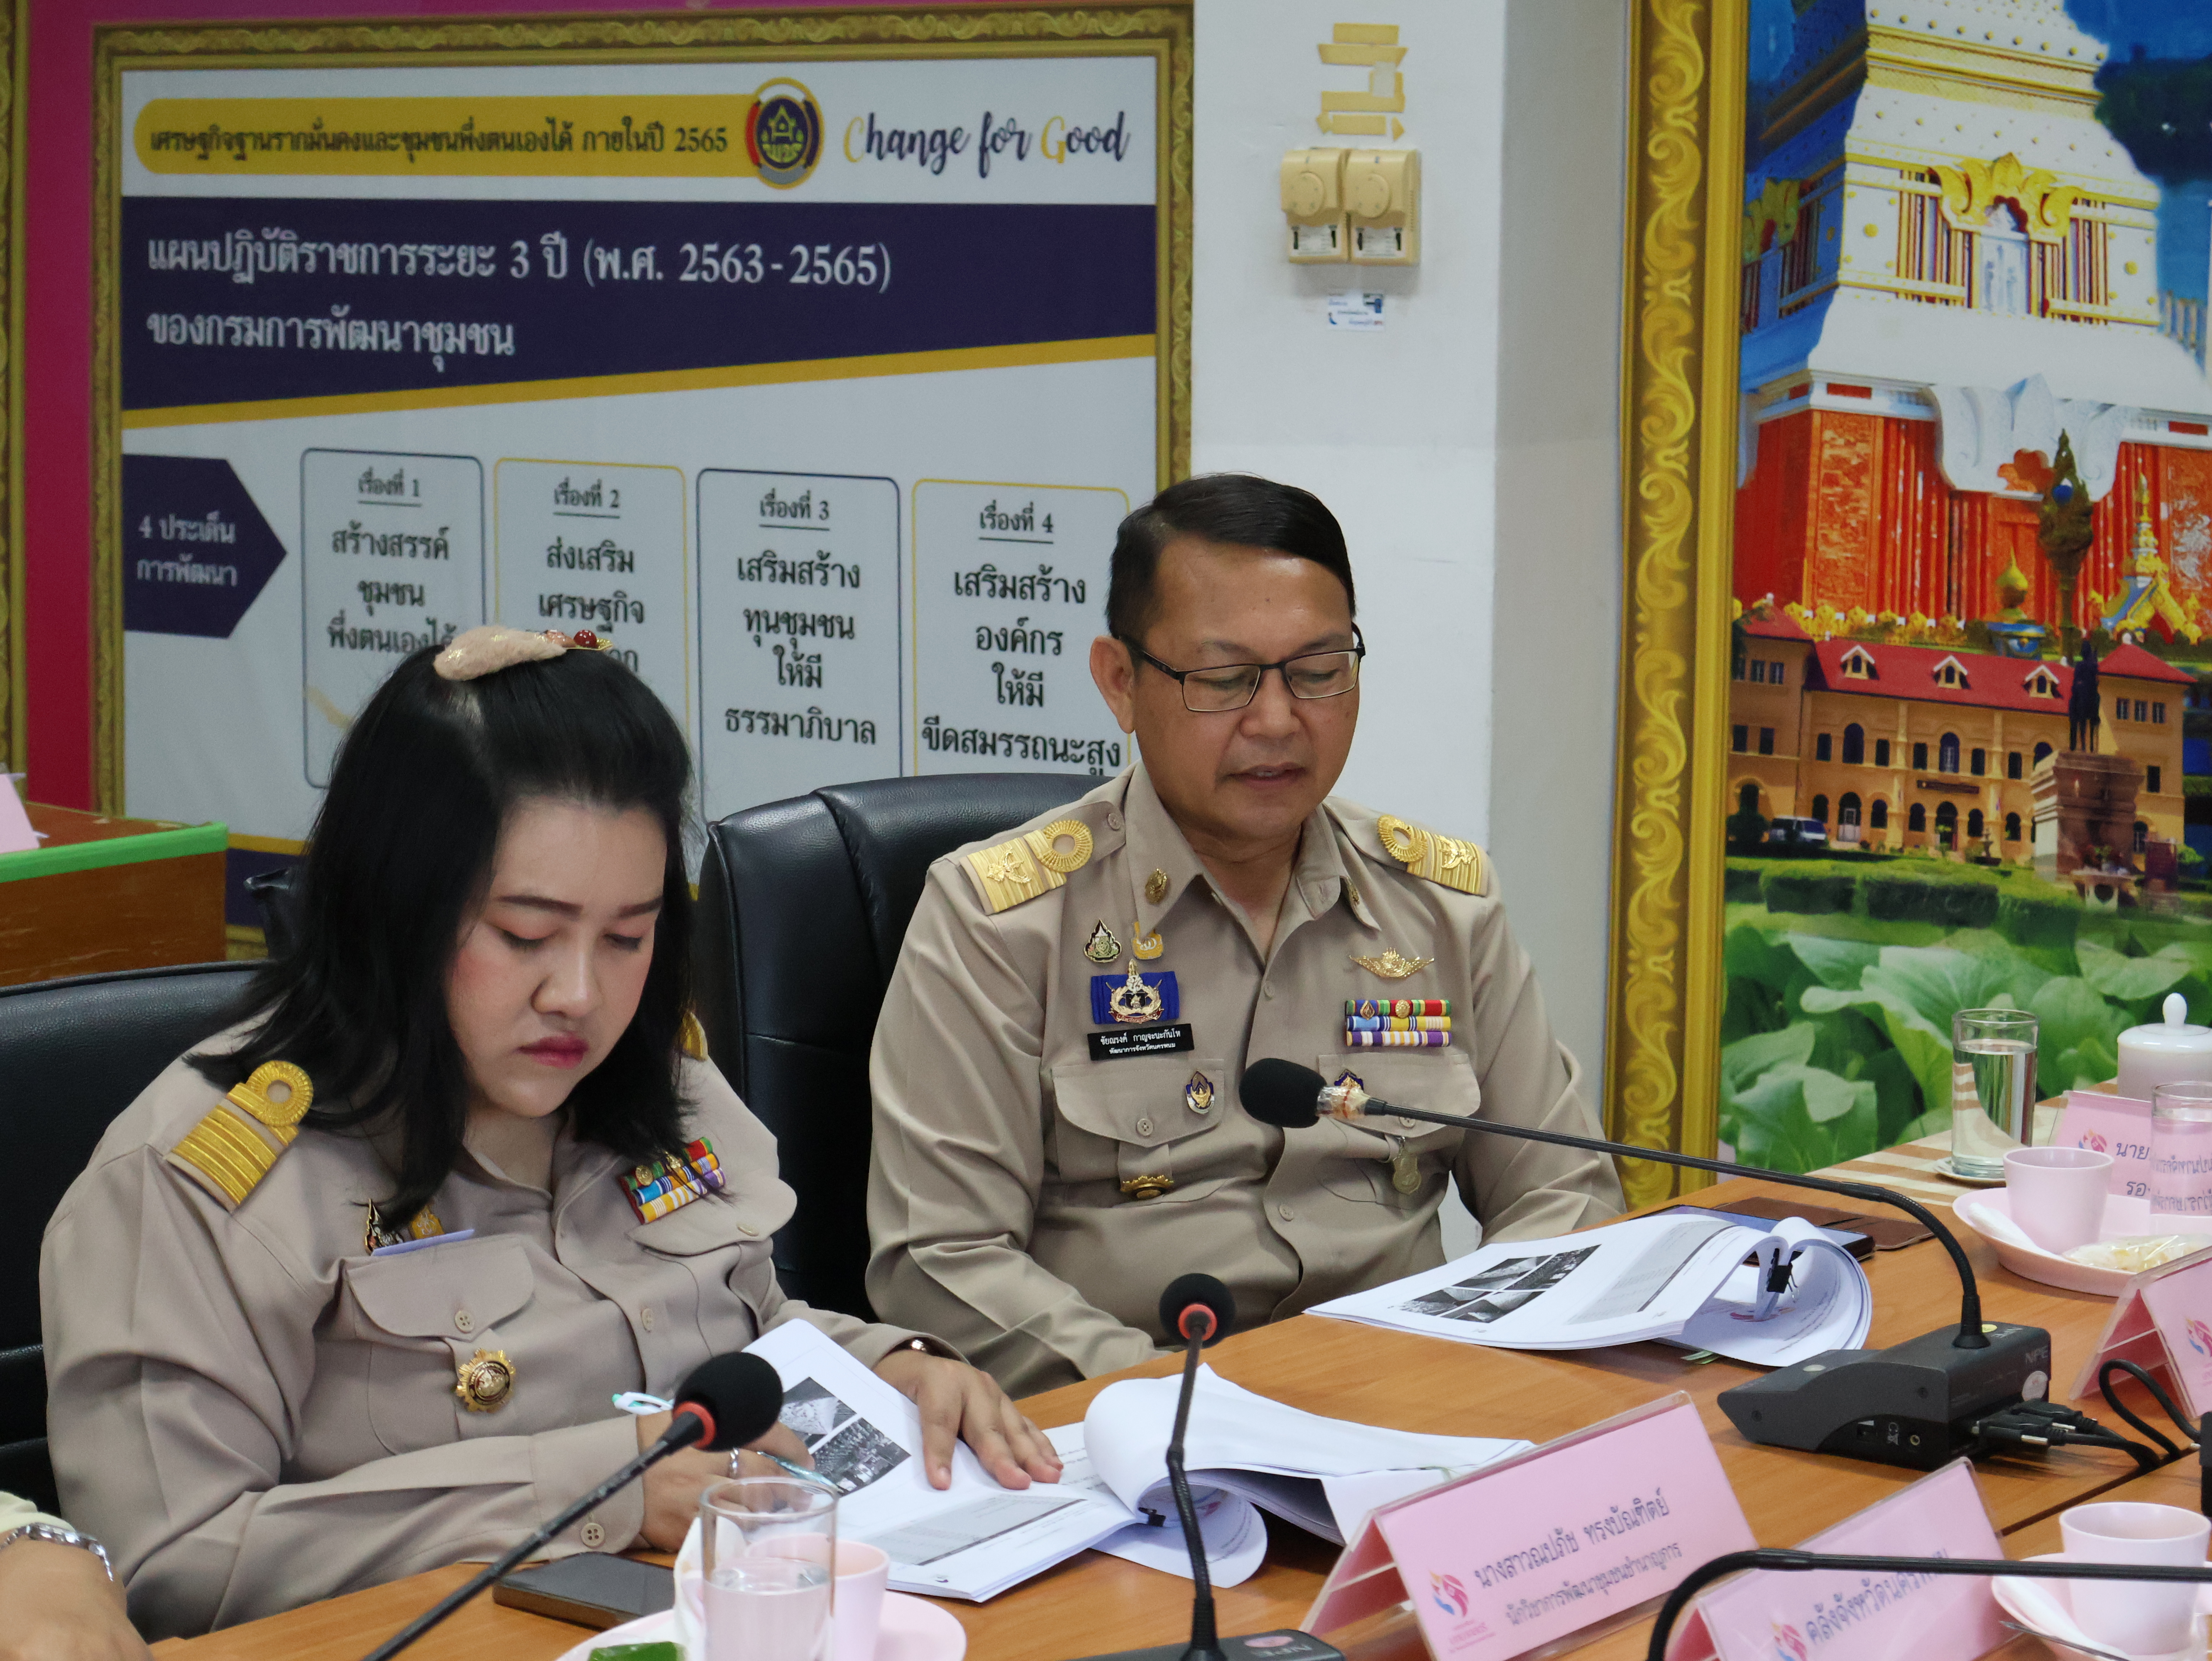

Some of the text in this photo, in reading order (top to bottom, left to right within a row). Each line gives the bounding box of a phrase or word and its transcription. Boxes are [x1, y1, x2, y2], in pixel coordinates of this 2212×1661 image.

[674, 127, 728, 152] 2565
[843, 111, 1130, 179] Change for Good
[148, 227, 497, 284] แผนปฏิบัติราชการระยะ
[510, 240, 530, 278] 3
[540, 231, 568, 279] ปี
[584, 238, 664, 287] (พ.ศ.
[147, 305, 515, 372] ของกรมการพัฒนาชุมชน
[412, 478, 421, 498] 1
[609, 489, 620, 510] 2
[759, 488, 830, 521] เรื่องที่ 3
[139, 515, 152, 539] 4
[979, 500, 1054, 534] เรื่องที่ 4
[332, 520, 450, 560] สร้างสรรค์
[546, 536, 635, 573] ส่งเสริม
[737, 549, 861, 589] เสริมสร้าง
[954, 563, 1086, 605] เสริมสร้าง
[357, 580, 425, 616] ชุมชน
[538, 590, 646, 633] เศรษฐกิจ
[743, 608, 855, 651] ทุนชุมชน
[975, 616, 1064, 657] องค์กร
[773, 644, 823, 688] ให้มี
[991, 661, 1045, 708] ให้มี
[724, 706, 877, 745] ธรรมาภิบาล
[921, 716, 1121, 774] ขีดสมรรถนะสูง
